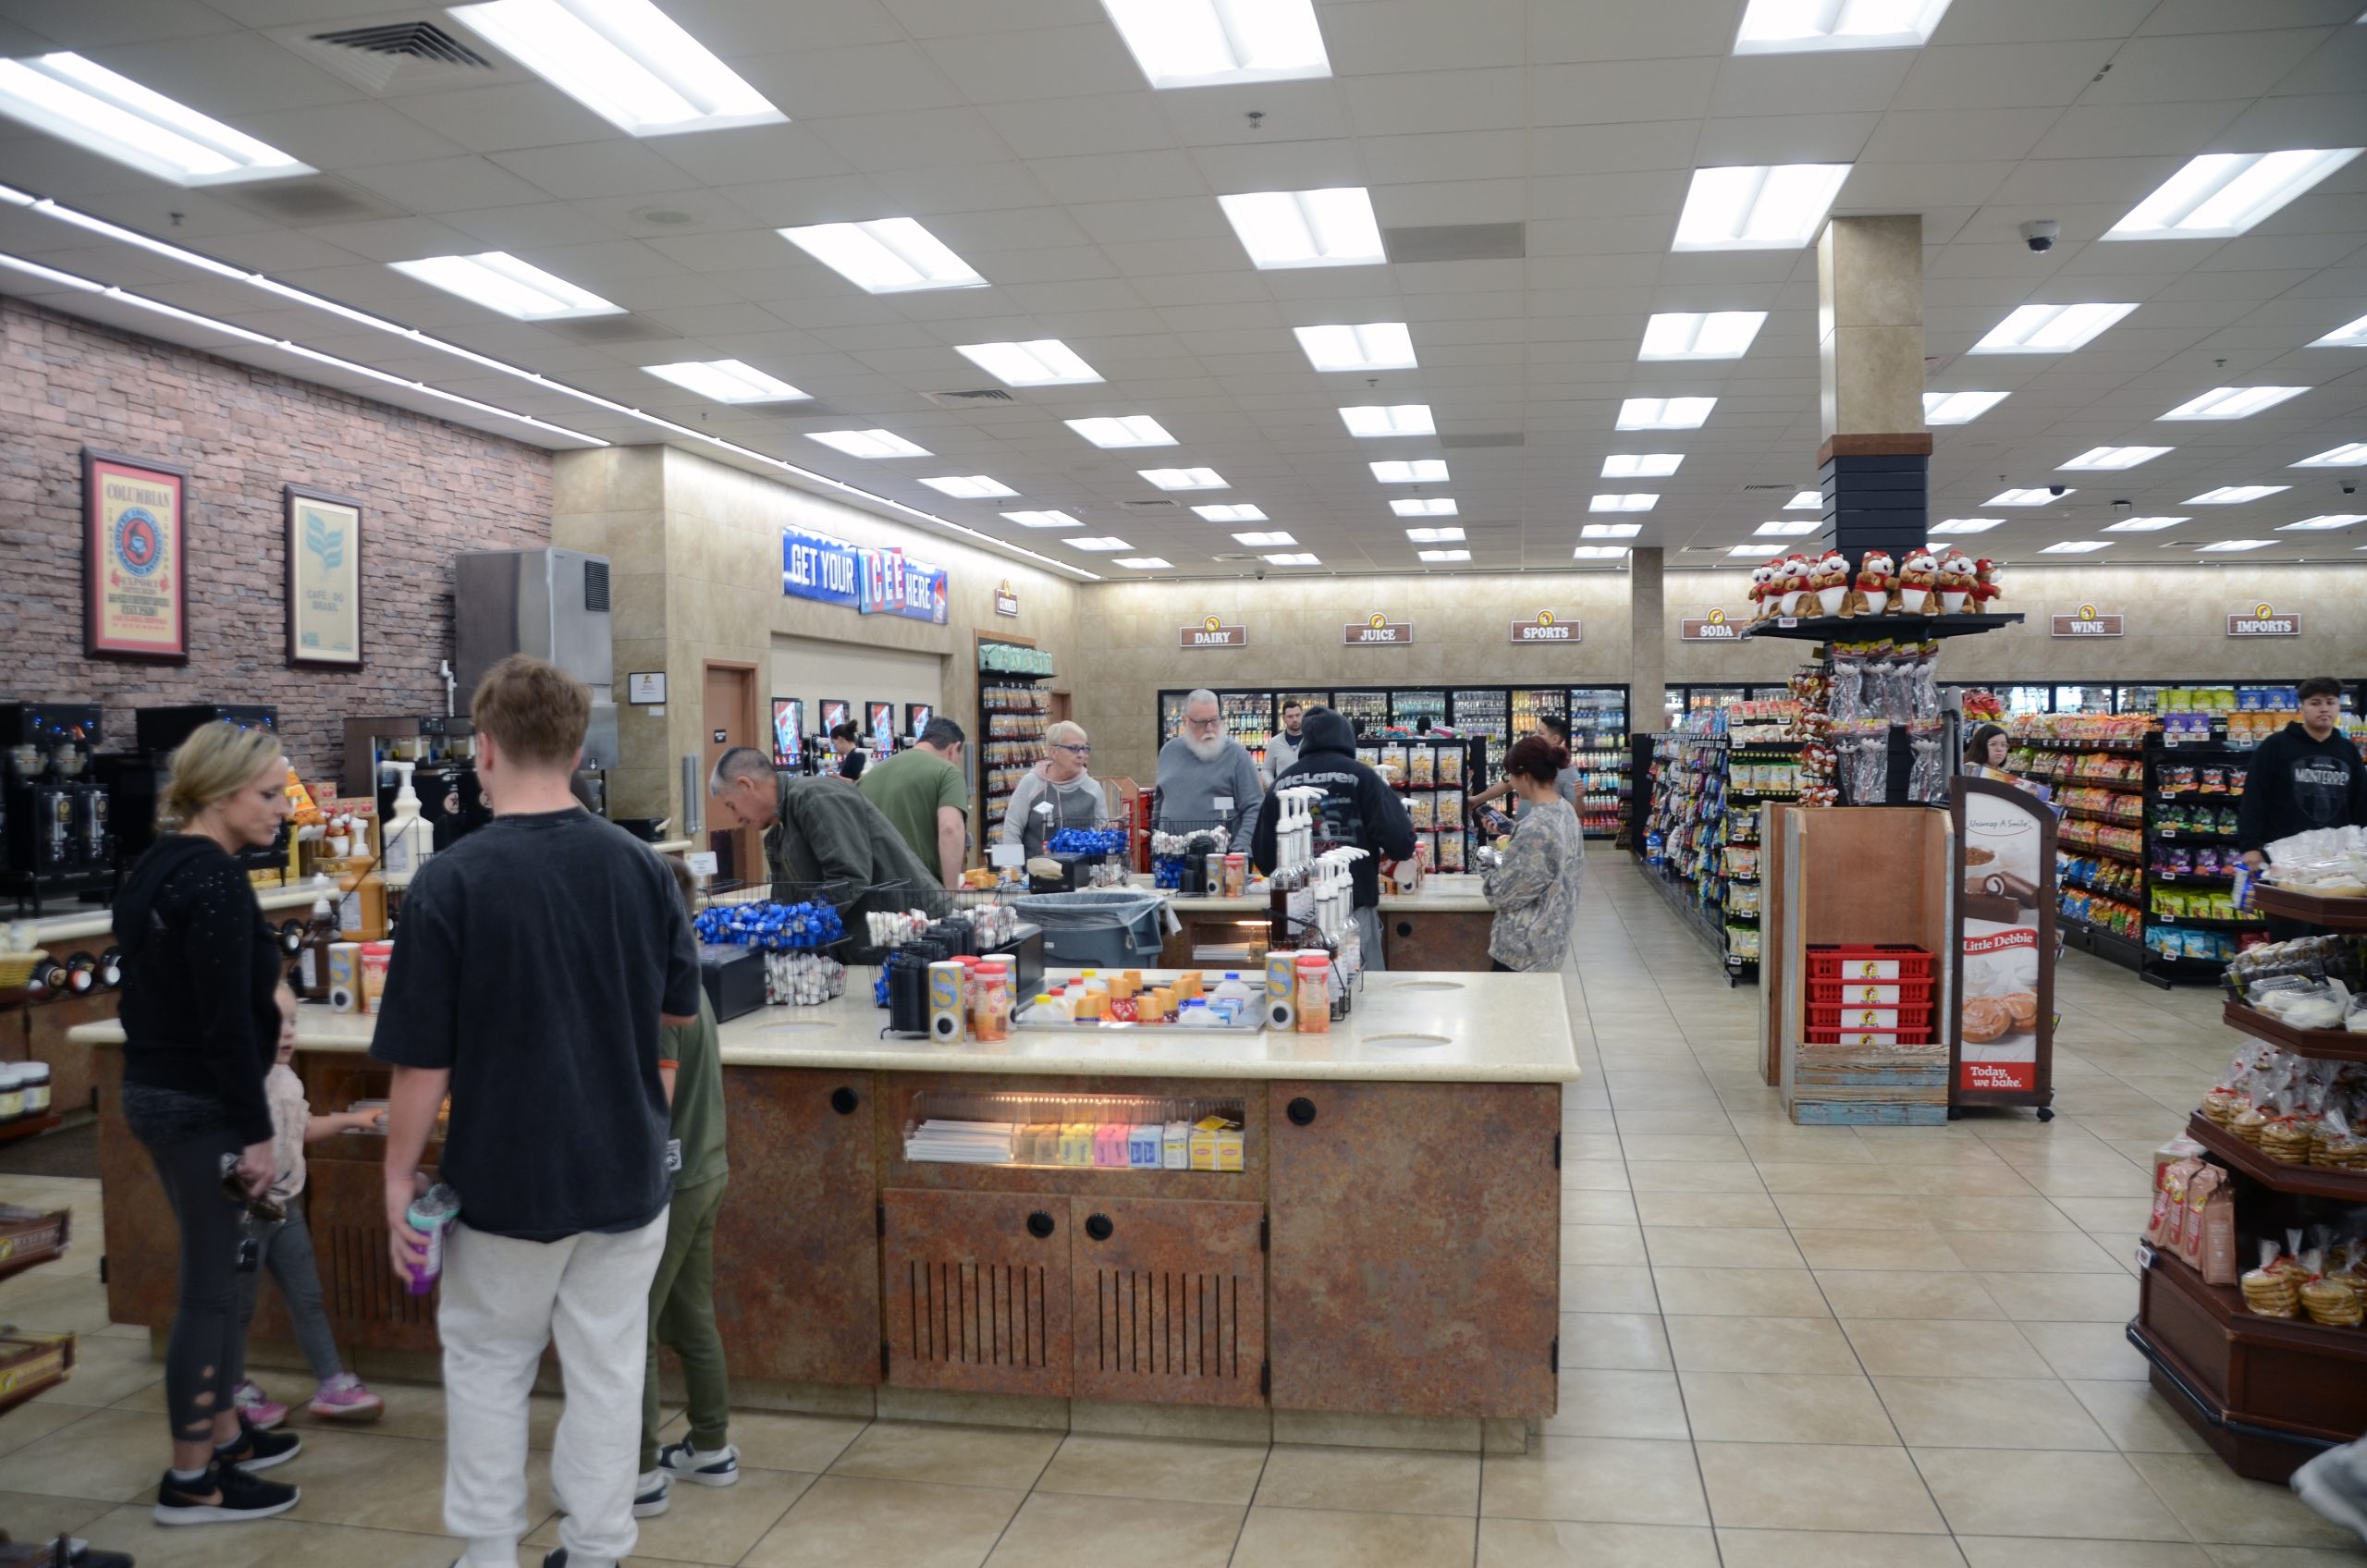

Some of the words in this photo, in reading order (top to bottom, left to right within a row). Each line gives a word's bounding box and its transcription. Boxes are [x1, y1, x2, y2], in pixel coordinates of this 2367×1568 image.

[107, 484, 170, 508] COLUMBIAN
[791, 543, 818, 586] GET
[821, 550, 855, 594] YOUR
[860, 553, 904, 604] ICEE
[905, 572, 932, 609] HERE
[333, 592, 345, 603] DO
[312, 599, 339, 612] BRASIL
[1699, 625, 1734, 637] SODA
[2070, 621, 2105, 633] WINE
[2237, 620, 2292, 632] IMPORTS
[1194, 631, 1232, 644] DAIRY
[1360, 629, 1396, 641] JUICE
[1523, 627, 1569, 639] SPORTS
[1968, 819, 1998, 828] Unwrap
[2007, 819, 2029, 827] Smile
[1963, 939, 1993, 951] Little
[1993, 933, 2033, 948] Debbie
[1969, 1065, 2008, 1079] Today,
[1973, 1079, 1990, 1087] we
